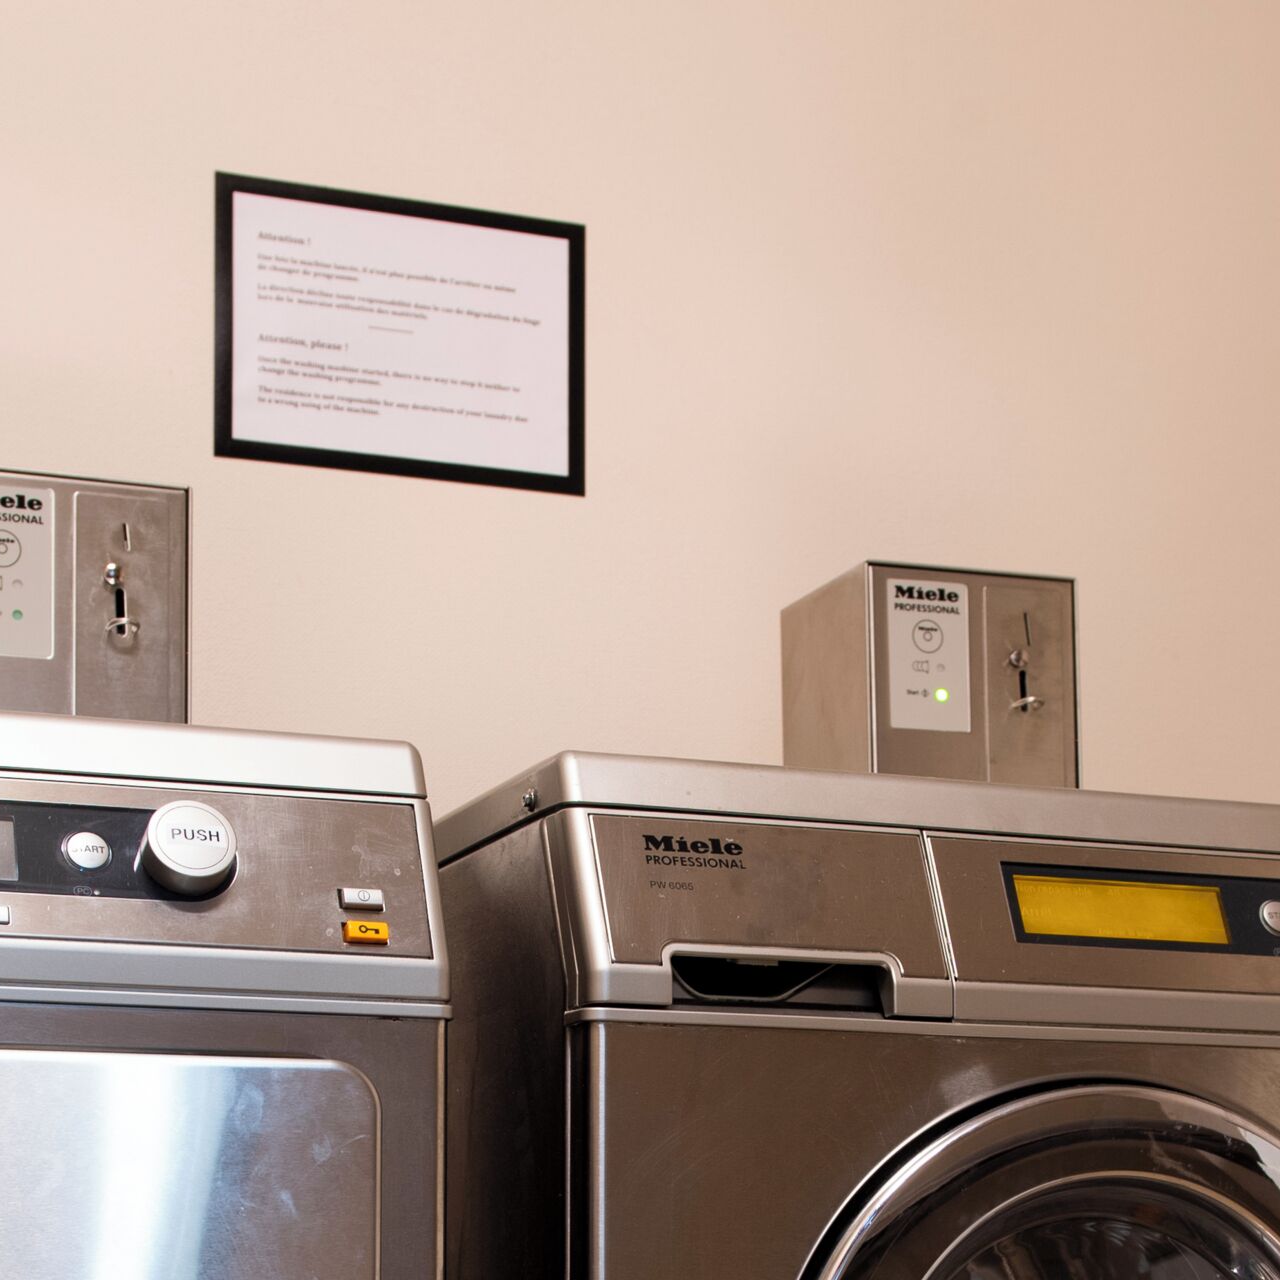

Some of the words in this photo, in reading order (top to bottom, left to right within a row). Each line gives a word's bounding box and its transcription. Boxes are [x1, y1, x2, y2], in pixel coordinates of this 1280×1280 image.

[257, 230, 304, 245] Attention
[310, 339, 342, 351] please
[279, 357, 291, 365] the
[293, 359, 325, 370] washing
[326, 363, 359, 373] machine
[257, 365, 285, 375] change
[286, 368, 299, 376] the
[302, 371, 332, 381] washing
[258, 384, 272, 393] The
[332, 404, 344, 412] the
[894, 585, 959, 603] Miele
[894, 602, 960, 615] PROFESSIONAL
[171, 828, 220, 842] PUSH
[642, 835, 743, 856] Miele
[645, 855, 747, 869] PROFESSIONAL
[650, 880, 666, 889] PW
